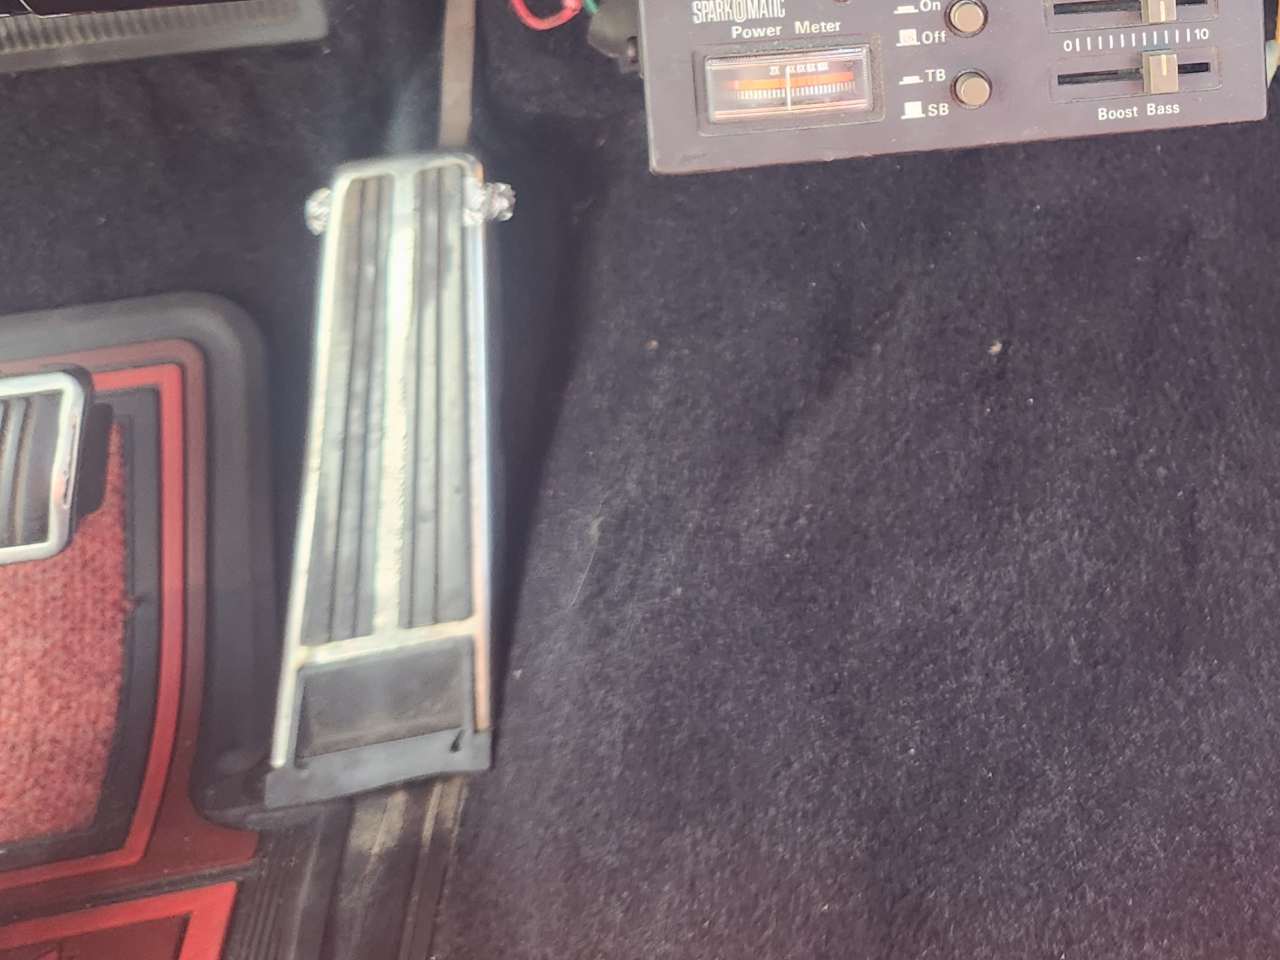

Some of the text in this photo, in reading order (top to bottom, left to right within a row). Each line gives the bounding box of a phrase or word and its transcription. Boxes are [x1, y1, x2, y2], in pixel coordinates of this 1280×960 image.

[731, 20, 841, 39] Power Meter
[1194, 27, 1209, 41] 10
[922, 30, 946, 45] Off
[925, 68, 946, 82] TB
[928, 102, 949, 117] SB
[1098, 102, 1180, 121] Boost Bass
